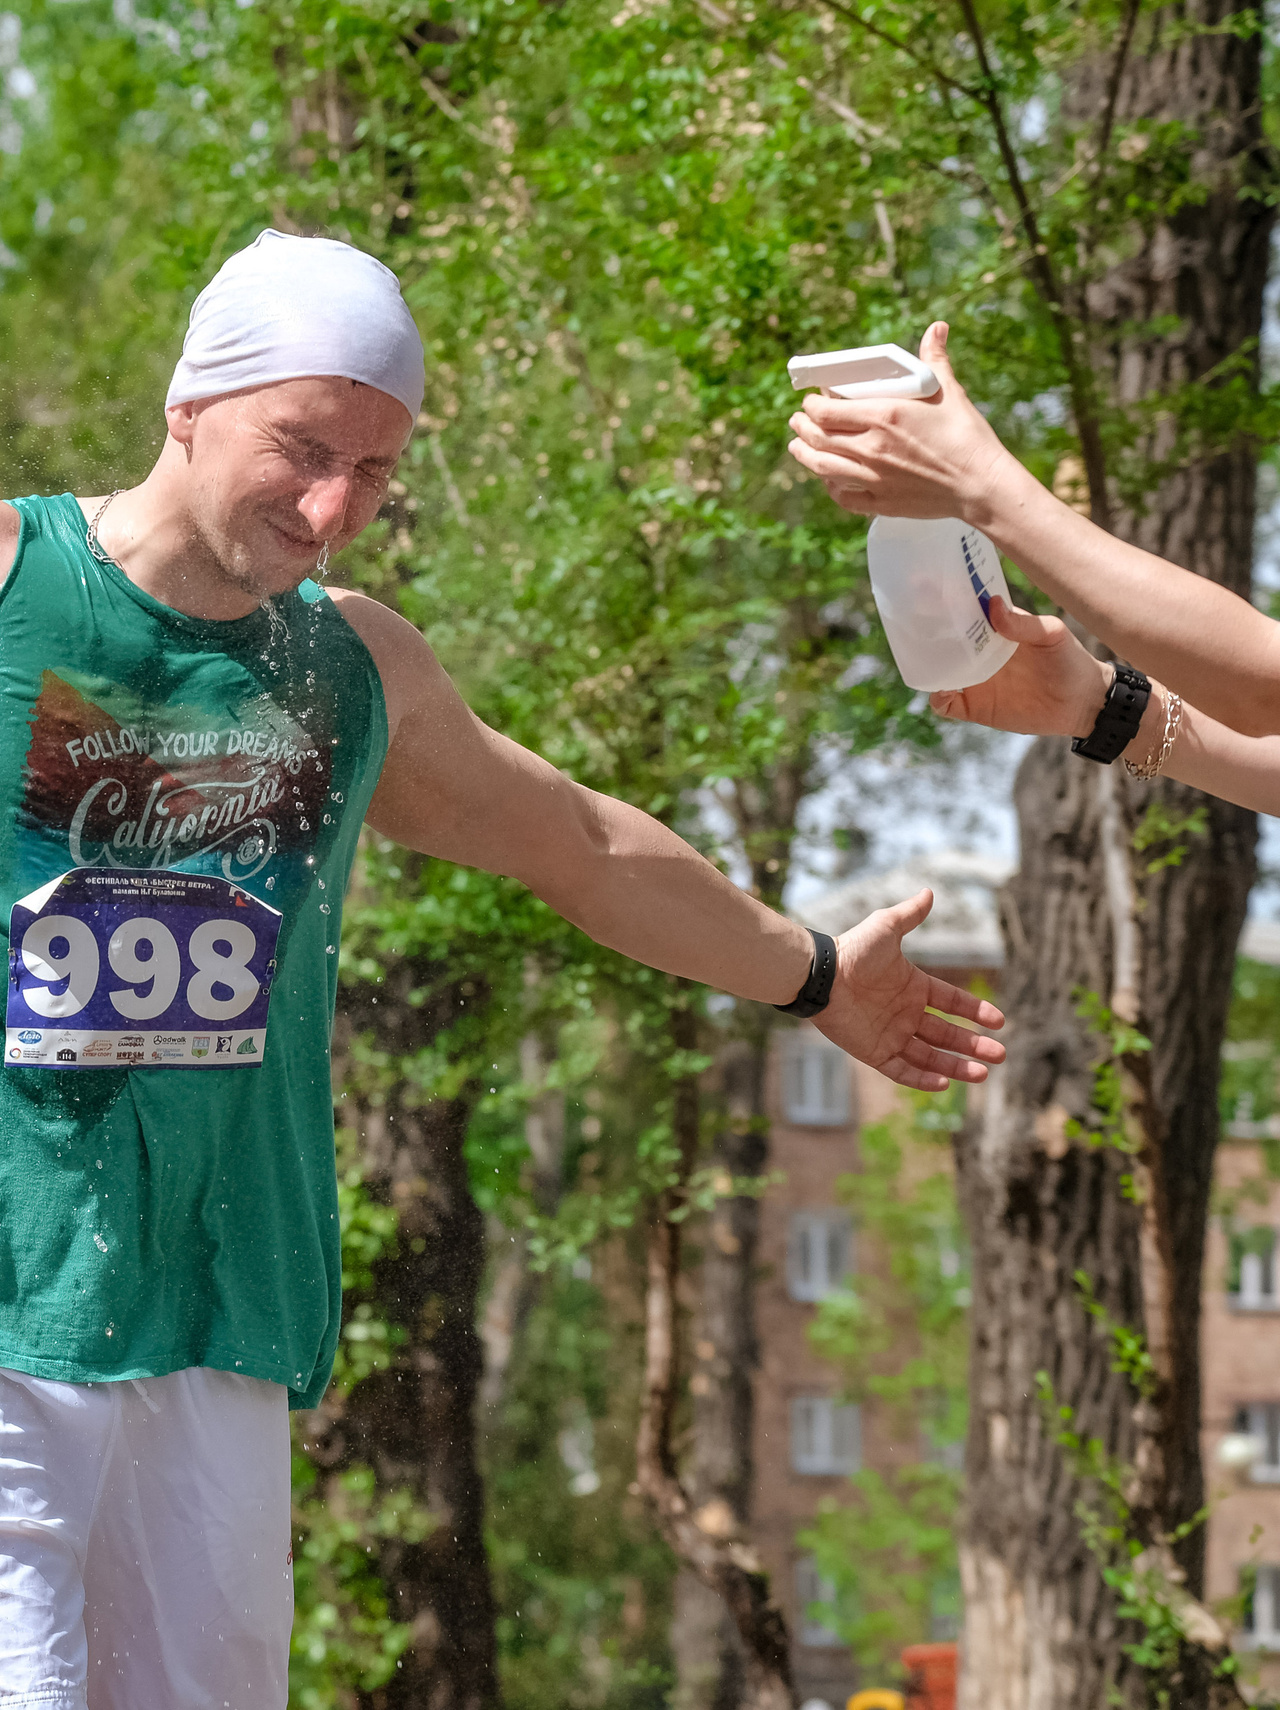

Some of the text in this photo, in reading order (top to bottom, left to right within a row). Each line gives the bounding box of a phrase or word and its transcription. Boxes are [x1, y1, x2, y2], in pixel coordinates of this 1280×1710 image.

[66, 729, 307, 775] FOLLOW YOUR DREAMS
[69, 766, 285, 875] California
[85, 877, 129, 885] ФЕСТИВАЛЬ
[21, 915, 261, 1020] 998
